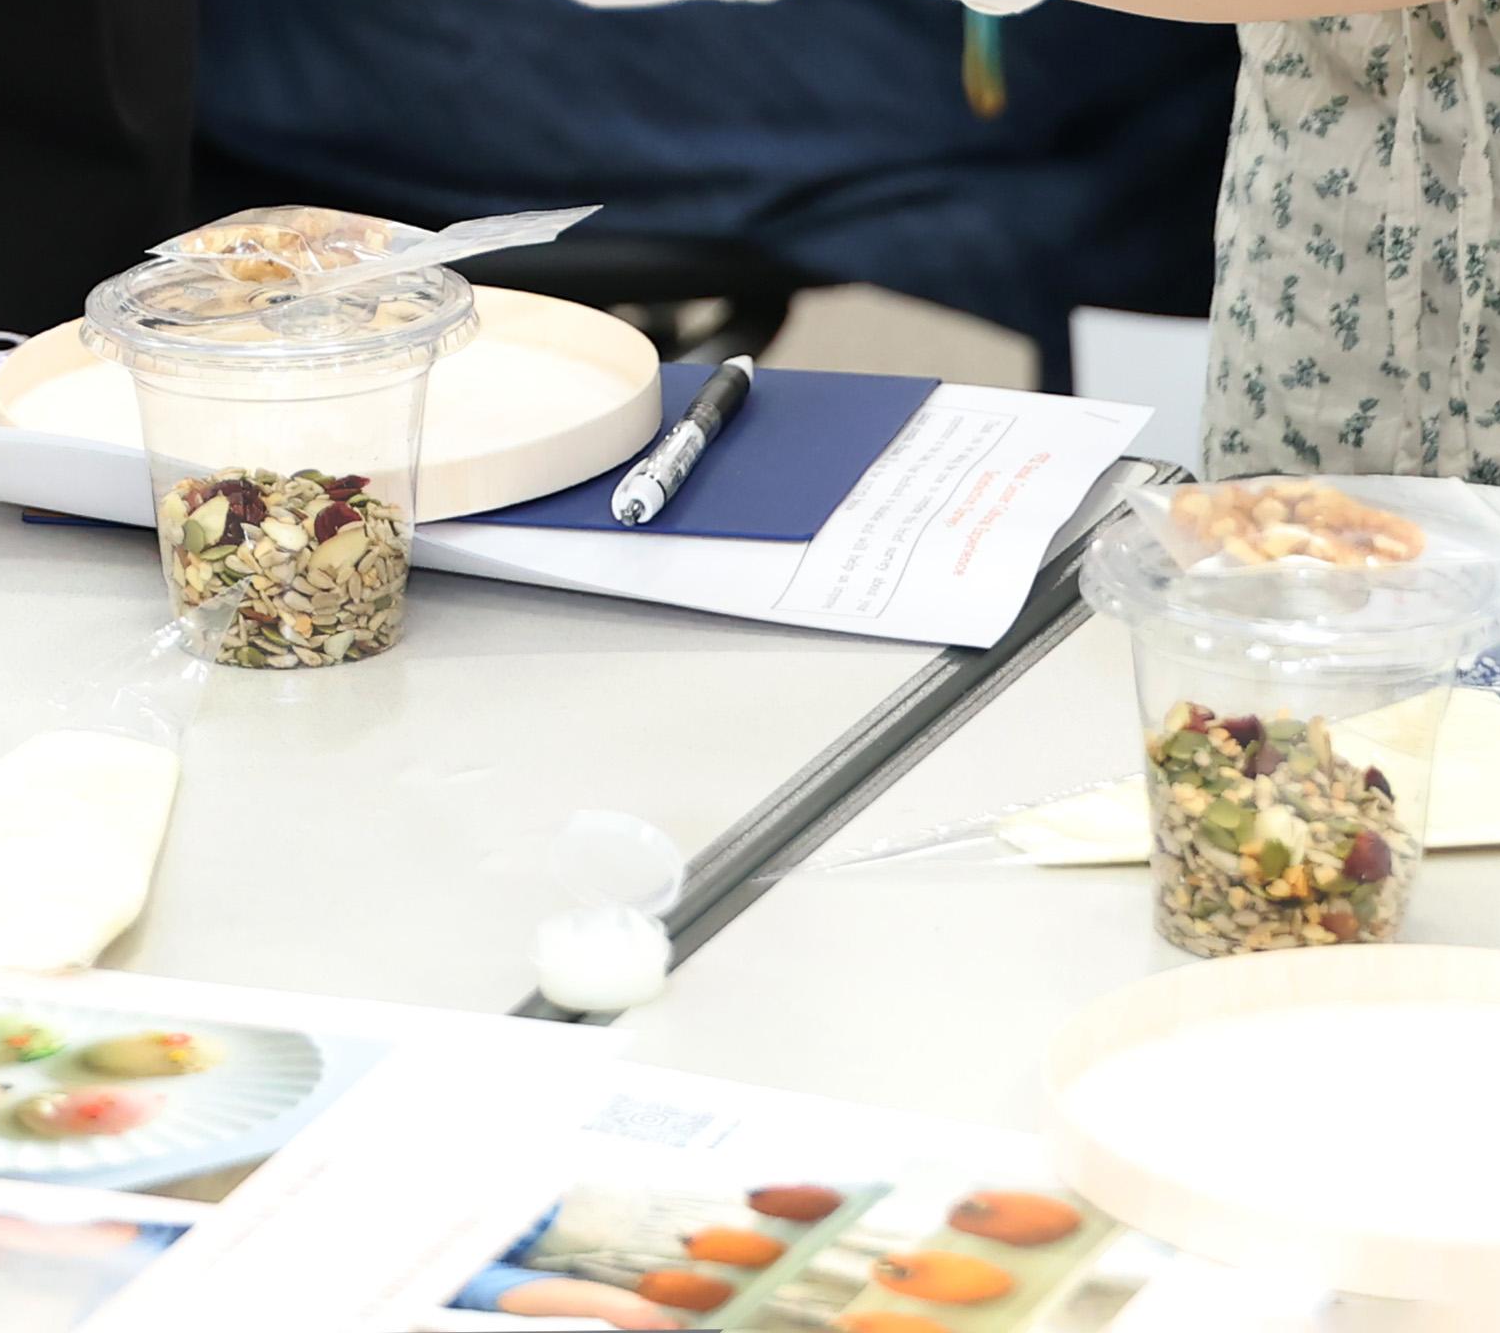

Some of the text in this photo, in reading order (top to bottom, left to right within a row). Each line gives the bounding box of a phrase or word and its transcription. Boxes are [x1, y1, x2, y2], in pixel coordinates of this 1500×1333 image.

[874, 546, 897, 571] survey
[953, 526, 990, 576] Experience
[841, 554, 863, 572] help
[866, 576, 887, 596] about
